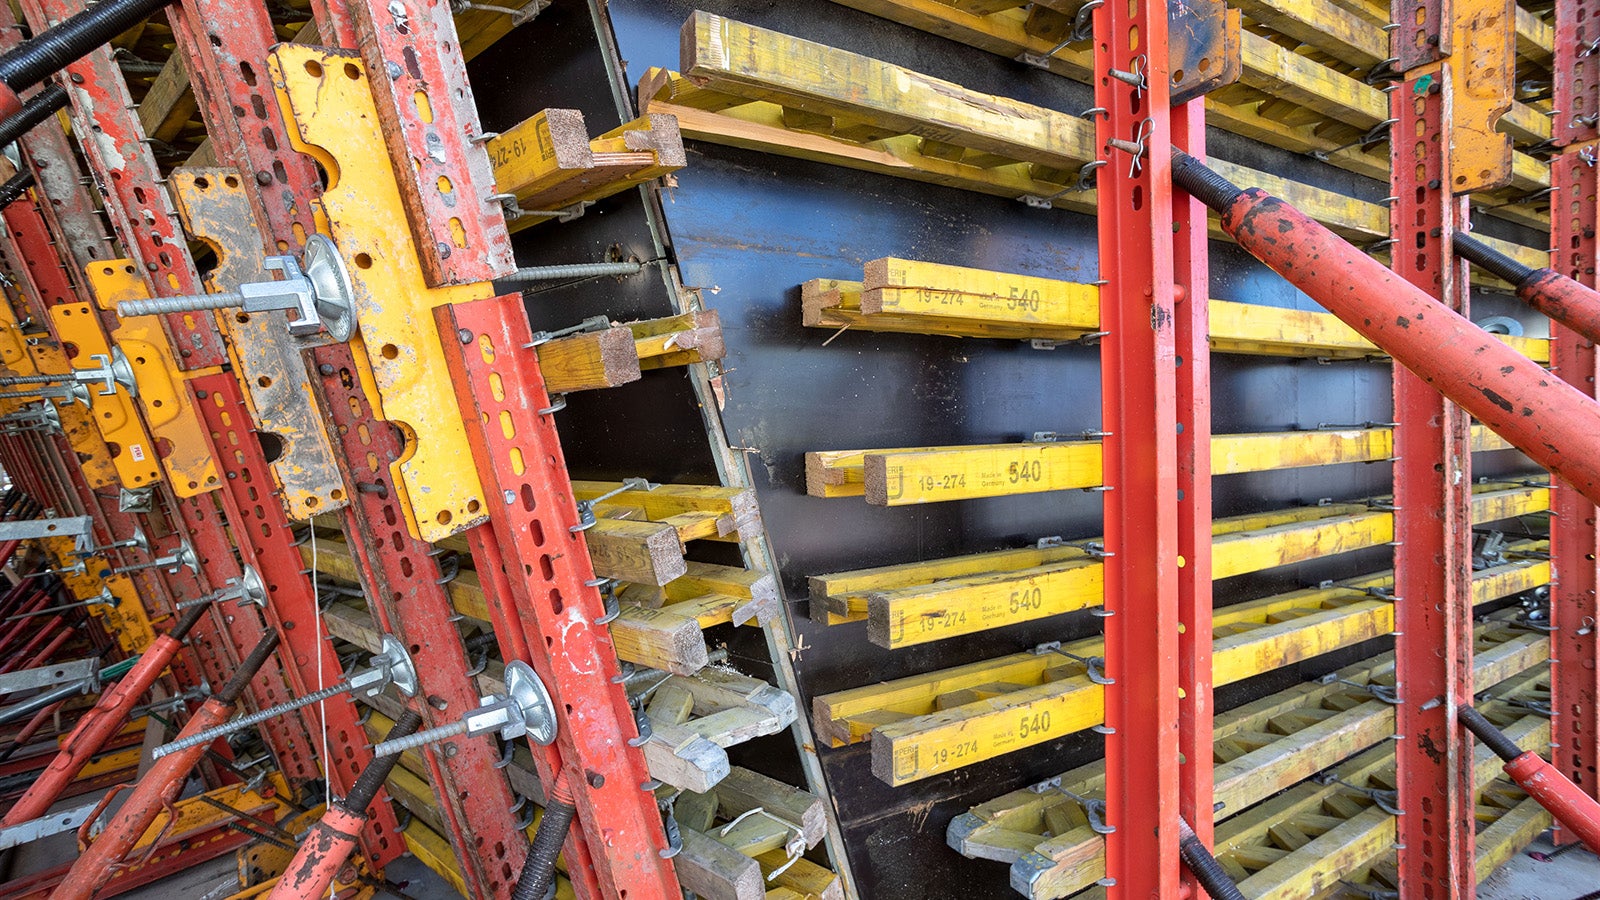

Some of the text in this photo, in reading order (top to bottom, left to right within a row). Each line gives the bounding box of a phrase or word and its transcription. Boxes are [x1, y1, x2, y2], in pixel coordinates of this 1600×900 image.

[916, 286, 963, 305] 19-274
[1007, 286, 1040, 312] 540
[979, 303, 1003, 311] Germany
[919, 474, 966, 491] 19-274
[1009, 460, 1041, 484] 540
[1010, 587, 1041, 614] 540
[919, 610, 966, 632] 19-274
[1019, 711, 1050, 738] 540
[899, 746, 914, 756] PERI
[933, 740, 978, 764] 19-274
[993, 738, 1016, 747] Germany
